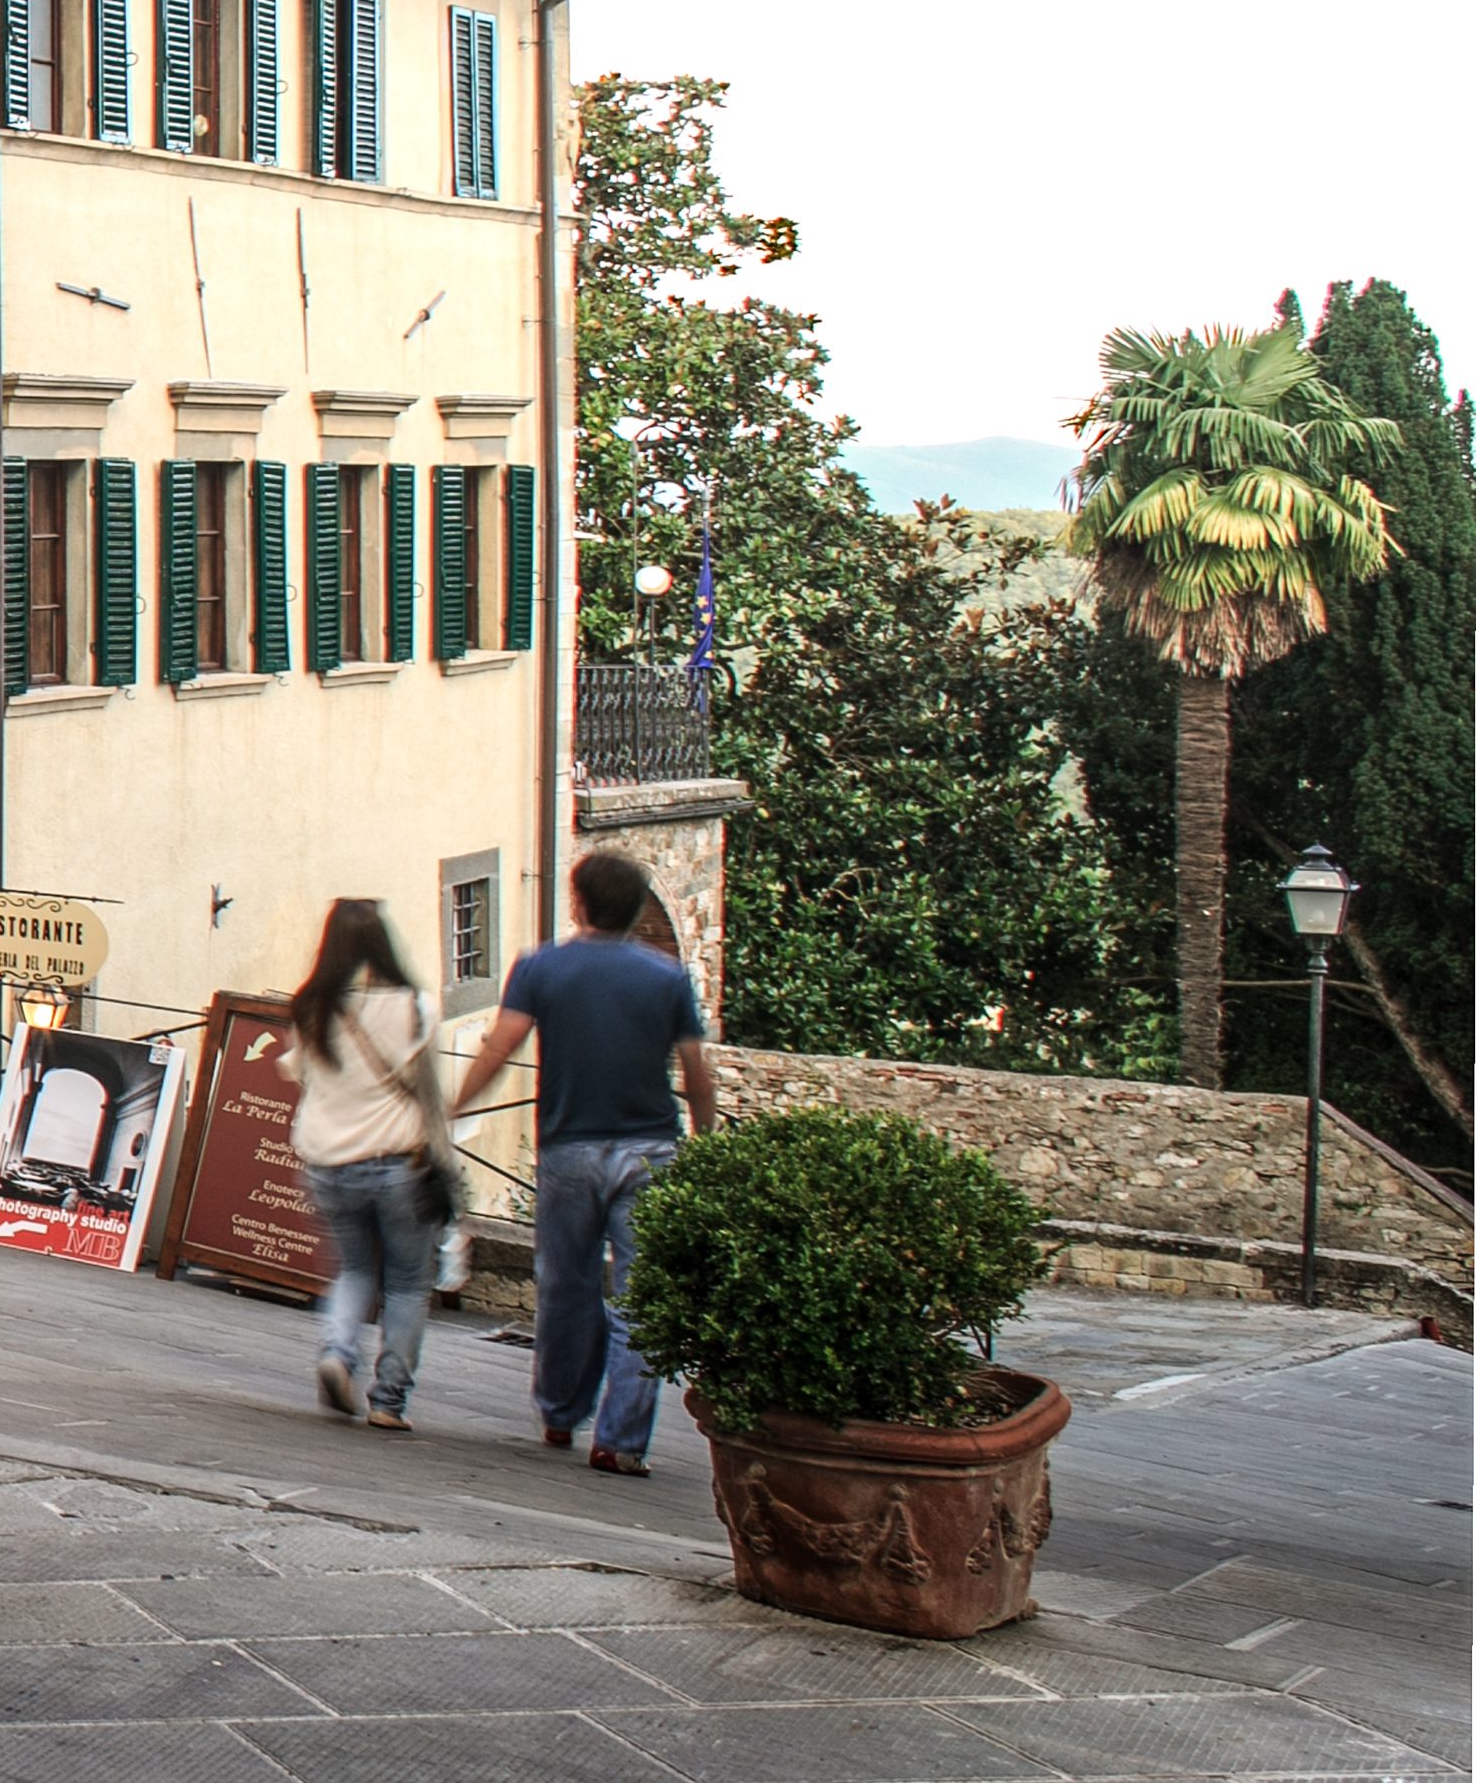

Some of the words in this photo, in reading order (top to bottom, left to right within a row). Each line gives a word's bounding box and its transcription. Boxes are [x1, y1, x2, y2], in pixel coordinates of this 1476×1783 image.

[25, 954, 39, 971] DEL
[47, 957, 85, 976] PALAZZO
[222, 1100, 242, 1114] La
[246, 1105, 287, 1125] Perla
[240, 1091, 293, 1112] Ristorante
[260, 1137, 294, 1153] Studio
[263, 1179, 305, 1198] Enoteca
[77, 1201, 105, 1218] fine
[109, 1210, 130, 1223] art
[248, 1189, 316, 1215] Leopoldo
[80, 1216, 127, 1235] studio
[231, 1213, 266, 1230] Centro
[268, 1222, 320, 1244] Benessere
[232, 1225, 276, 1245] Wellness
[278, 1238, 313, 1255] Centre
[252, 1243, 289, 1262] Elisa
